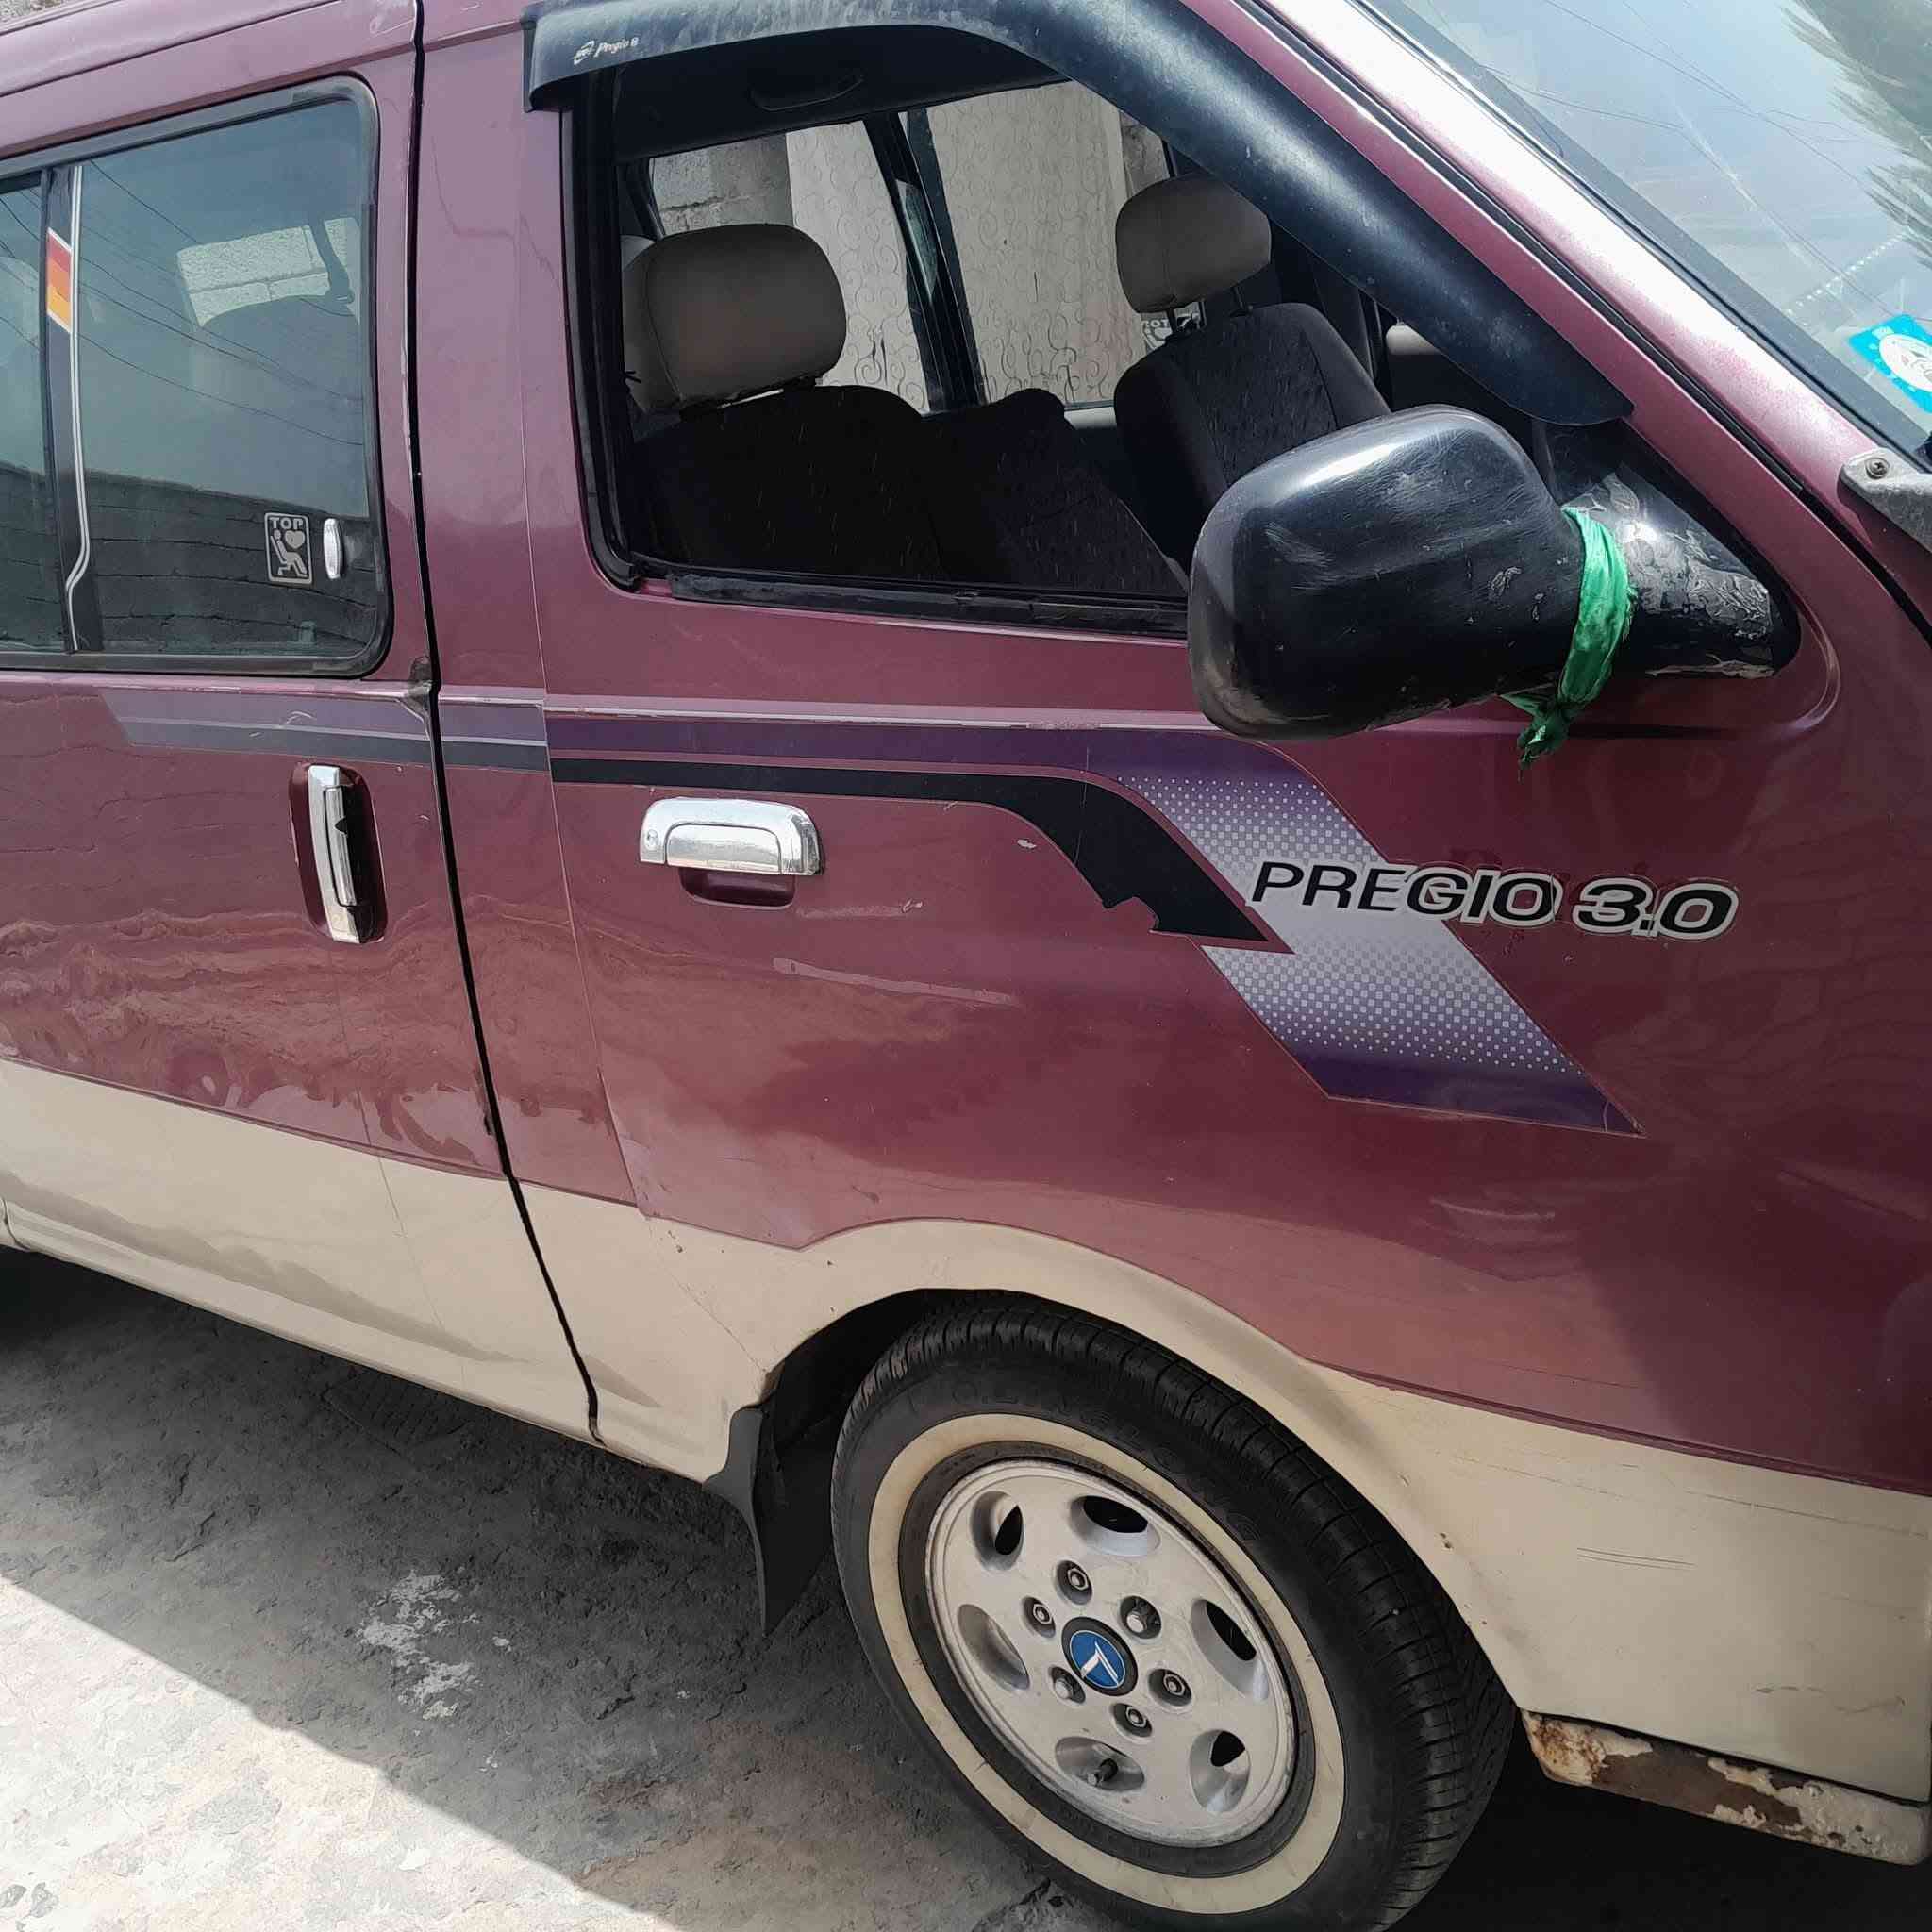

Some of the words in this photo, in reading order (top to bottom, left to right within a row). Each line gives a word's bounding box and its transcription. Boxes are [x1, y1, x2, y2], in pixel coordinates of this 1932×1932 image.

[269, 517, 304, 529] TOP
[1250, 860, 1561, 924] PREGIO
[1572, 877, 1740, 939] 3.0
